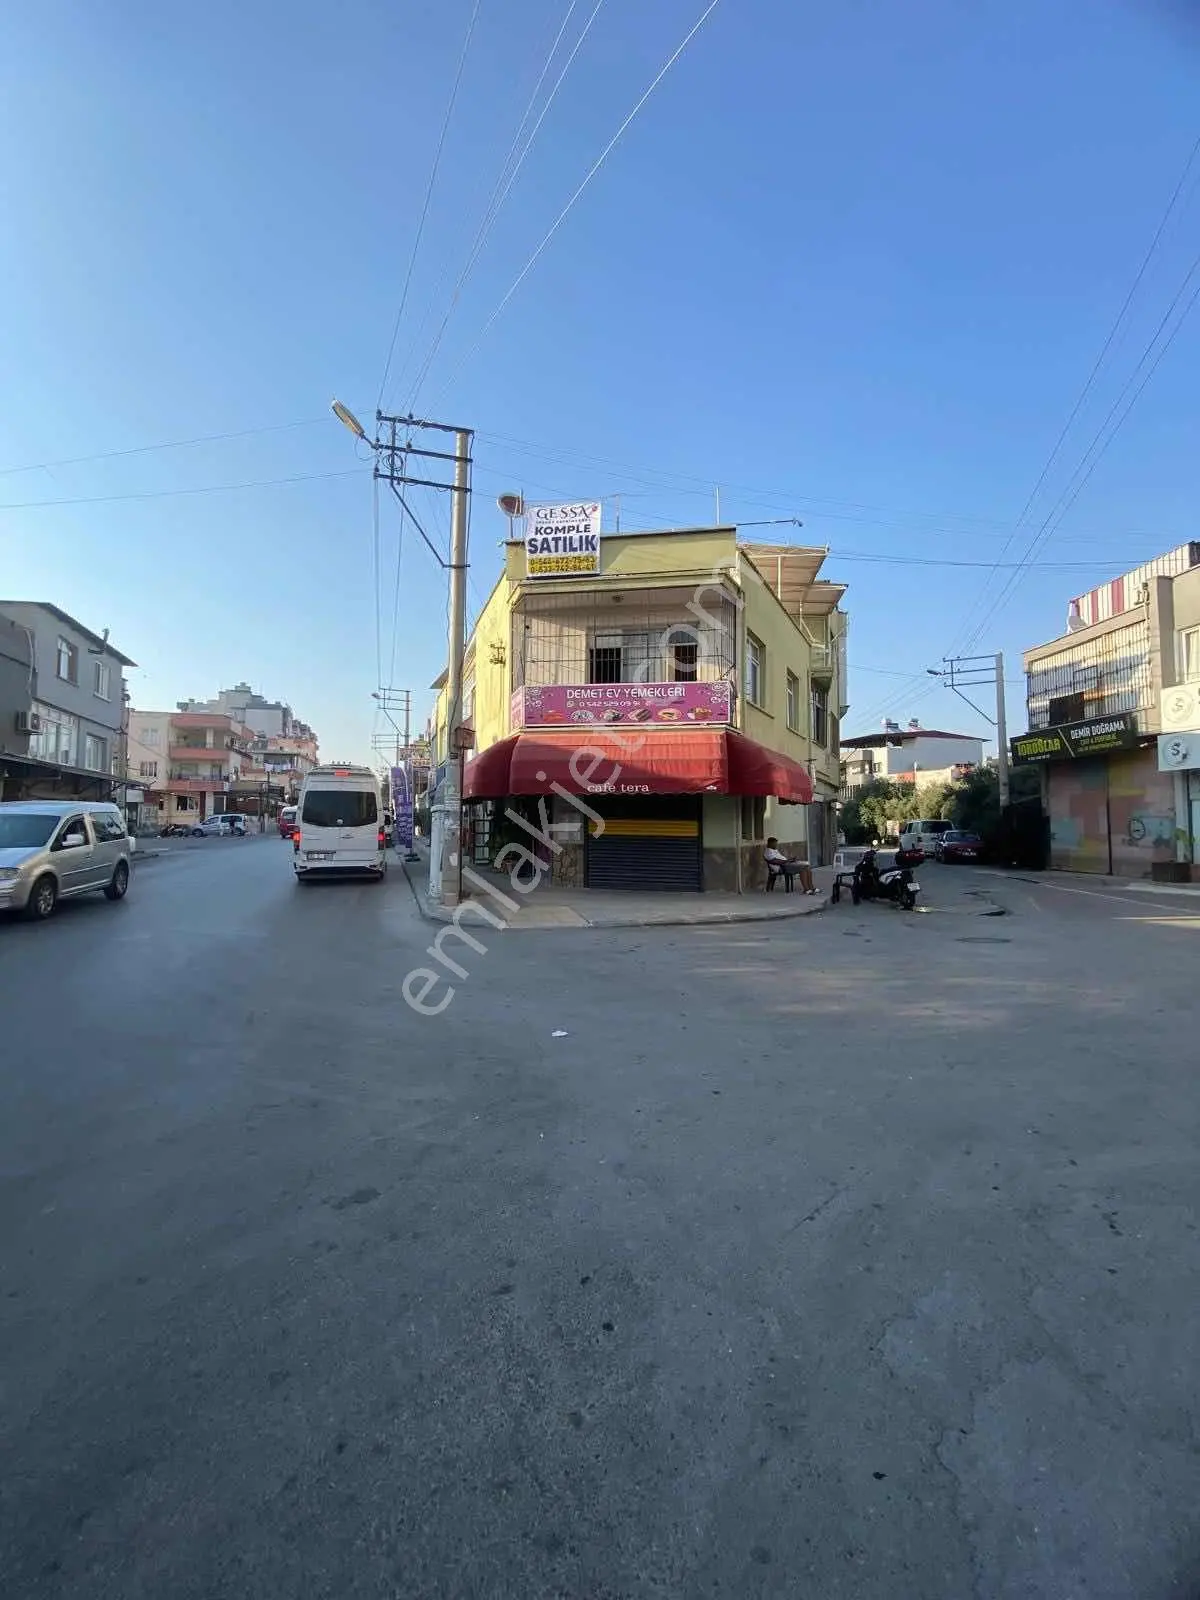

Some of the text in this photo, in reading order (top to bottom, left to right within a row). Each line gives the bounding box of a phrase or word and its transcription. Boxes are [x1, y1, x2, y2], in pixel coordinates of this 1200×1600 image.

[536, 505, 590, 520] GESSA
[535, 524, 591, 536] KOMPLE
[527, 534, 597, 554] SATILIK
[566, 688, 603, 699] DEMET
[606, 688, 621, 698] EV
[587, 782, 649, 793] cafe tera
